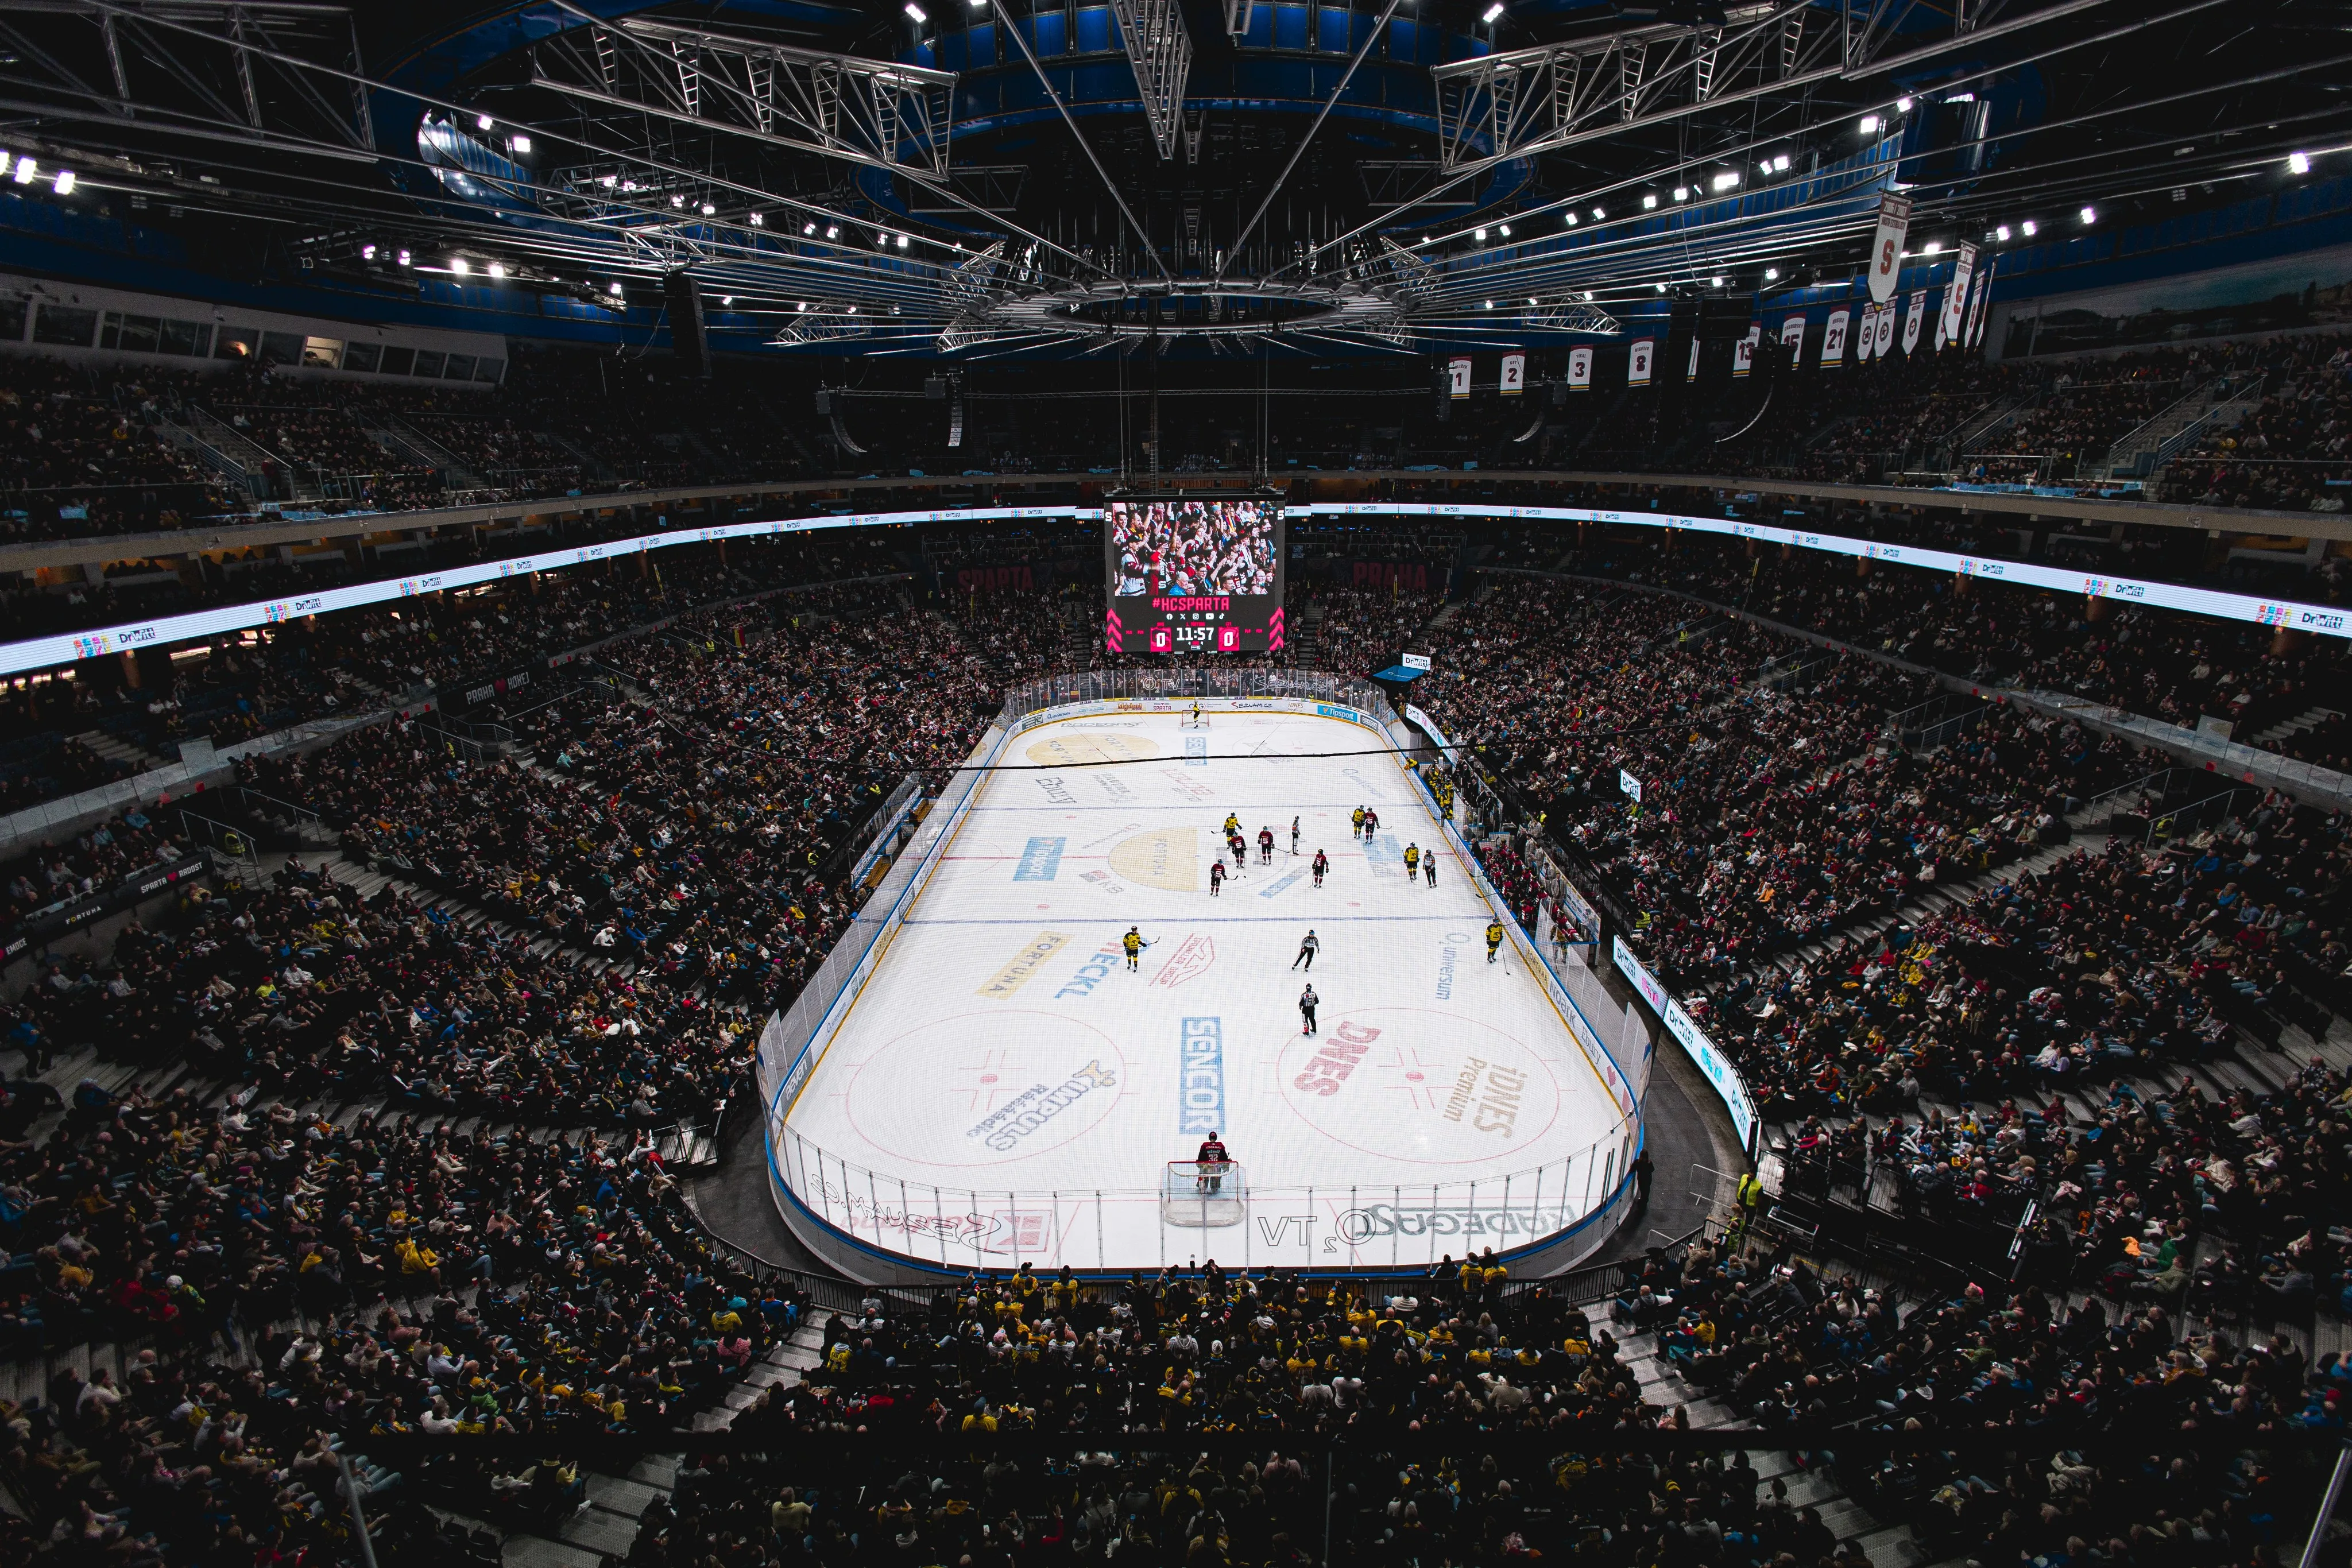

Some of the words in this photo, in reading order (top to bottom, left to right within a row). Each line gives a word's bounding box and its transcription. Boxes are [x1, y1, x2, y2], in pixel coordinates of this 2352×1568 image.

[1880, 239, 1895, 276] S
[1827, 328, 1844, 350] 21
[1575, 362, 1585, 378] 3
[1637, 355, 1646, 372] 8
[1456, 372, 1462, 386] 1
[1508, 368, 1518, 383] 2
[1105, 512, 1112, 522] S
[1277, 510, 1284, 520] S
[1152, 597, 1229, 611] #HCSPARTA
[2301, 613, 2343, 629] DrWitt
[118, 627, 157, 644] DrWitt
[1156, 632, 1166, 647] 0
[1177, 627, 1214, 641] 11:57
[1224, 632, 1233, 646] 0
[1405, 657, 1428, 667] DrWitt
[466, 684, 495, 705] PRAHA
[507, 671, 530, 690] HOKEJ
[1161, 679, 1180, 691] TV
[1231, 701, 1273, 710] SEZNAM.CZ
[1329, 707, 1354, 719] Tipsport
[1046, 740, 1076, 764] FORTUN
[141, 877, 168, 893] SPARTA
[179, 861, 203, 878] RADOST
[65, 905, 102, 925] FORTUNA
[988, 936, 1062, 992] FORTUNA
[1054, 941, 1124, 999] HECKL
[1581, 1025, 1601, 1065] Ebury
[1293, 1020, 1382, 1096] DNES
[1187, 1019, 1219, 1132] SENCOR
[1444, 1056, 1488, 1122] Premium
[1473, 1064, 1528, 1138] iDNES
[985, 1080, 1089, 1151] IMPULS
[1355, 1203, 1577, 1236] RADEGAST
